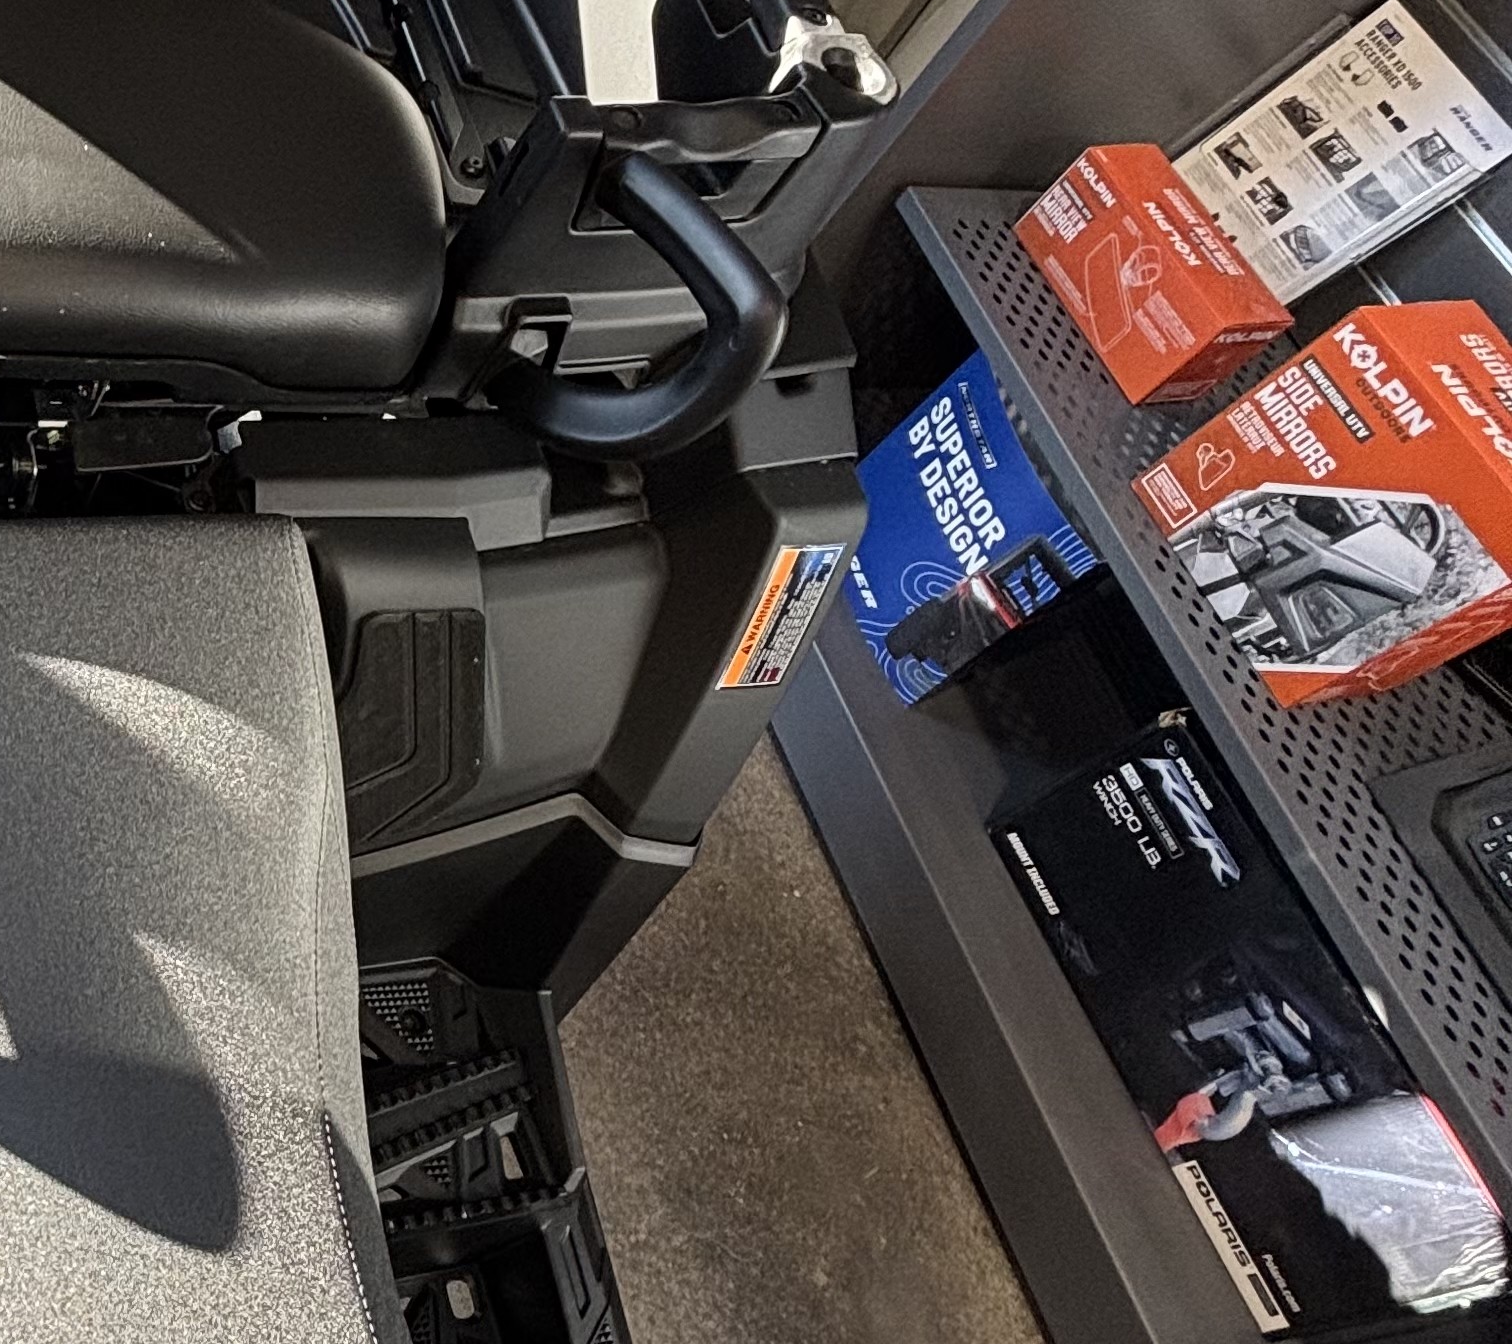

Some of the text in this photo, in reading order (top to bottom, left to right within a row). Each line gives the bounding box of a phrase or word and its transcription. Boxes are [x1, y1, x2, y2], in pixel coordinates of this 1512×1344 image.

[1354, 38, 1401, 89] ACCESSORIES
[1366, 29, 1422, 90] RANGER XD 1500
[1051, 185, 1087, 231] REAR VIEW
[1077, 158, 1116, 207] KOLPIN
[1040, 194, 1078, 243] MIRROR
[1143, 202, 1201, 265] KOLPIN
[1278, 366, 1322, 415] SIDE
[1304, 359, 1369, 437] UNIVERSAL UTV
[1334, 324, 1432, 435] KOLPIN
[1355, 378, 1411, 443] OUTDOORS
[1255, 382, 1335, 478] MIRRORS
[1431, 363, 1512, 464] OLPIN
[908, 416, 987, 575] BY DESIGN
[931, 398, 1004, 548] SUPERIOR
[746, 584, 780, 642] WARNING
[1093, 781, 1121, 825] WINCH
[1123, 766, 1139, 787] HD
[1140, 794, 1155, 813] HEAVY
[1151, 813, 1165, 830] DUTY
[1176, 757, 1213, 810] POLARIS
[1102, 775, 1161, 868] 3500 LB.
[1143, 758, 1239, 880] RZR
[1007, 832, 1059, 915] MOUNT INCLUDED
[1187, 1165, 1250, 1266] POLARIS
[1262, 1254, 1300, 1312] Polaris.com
